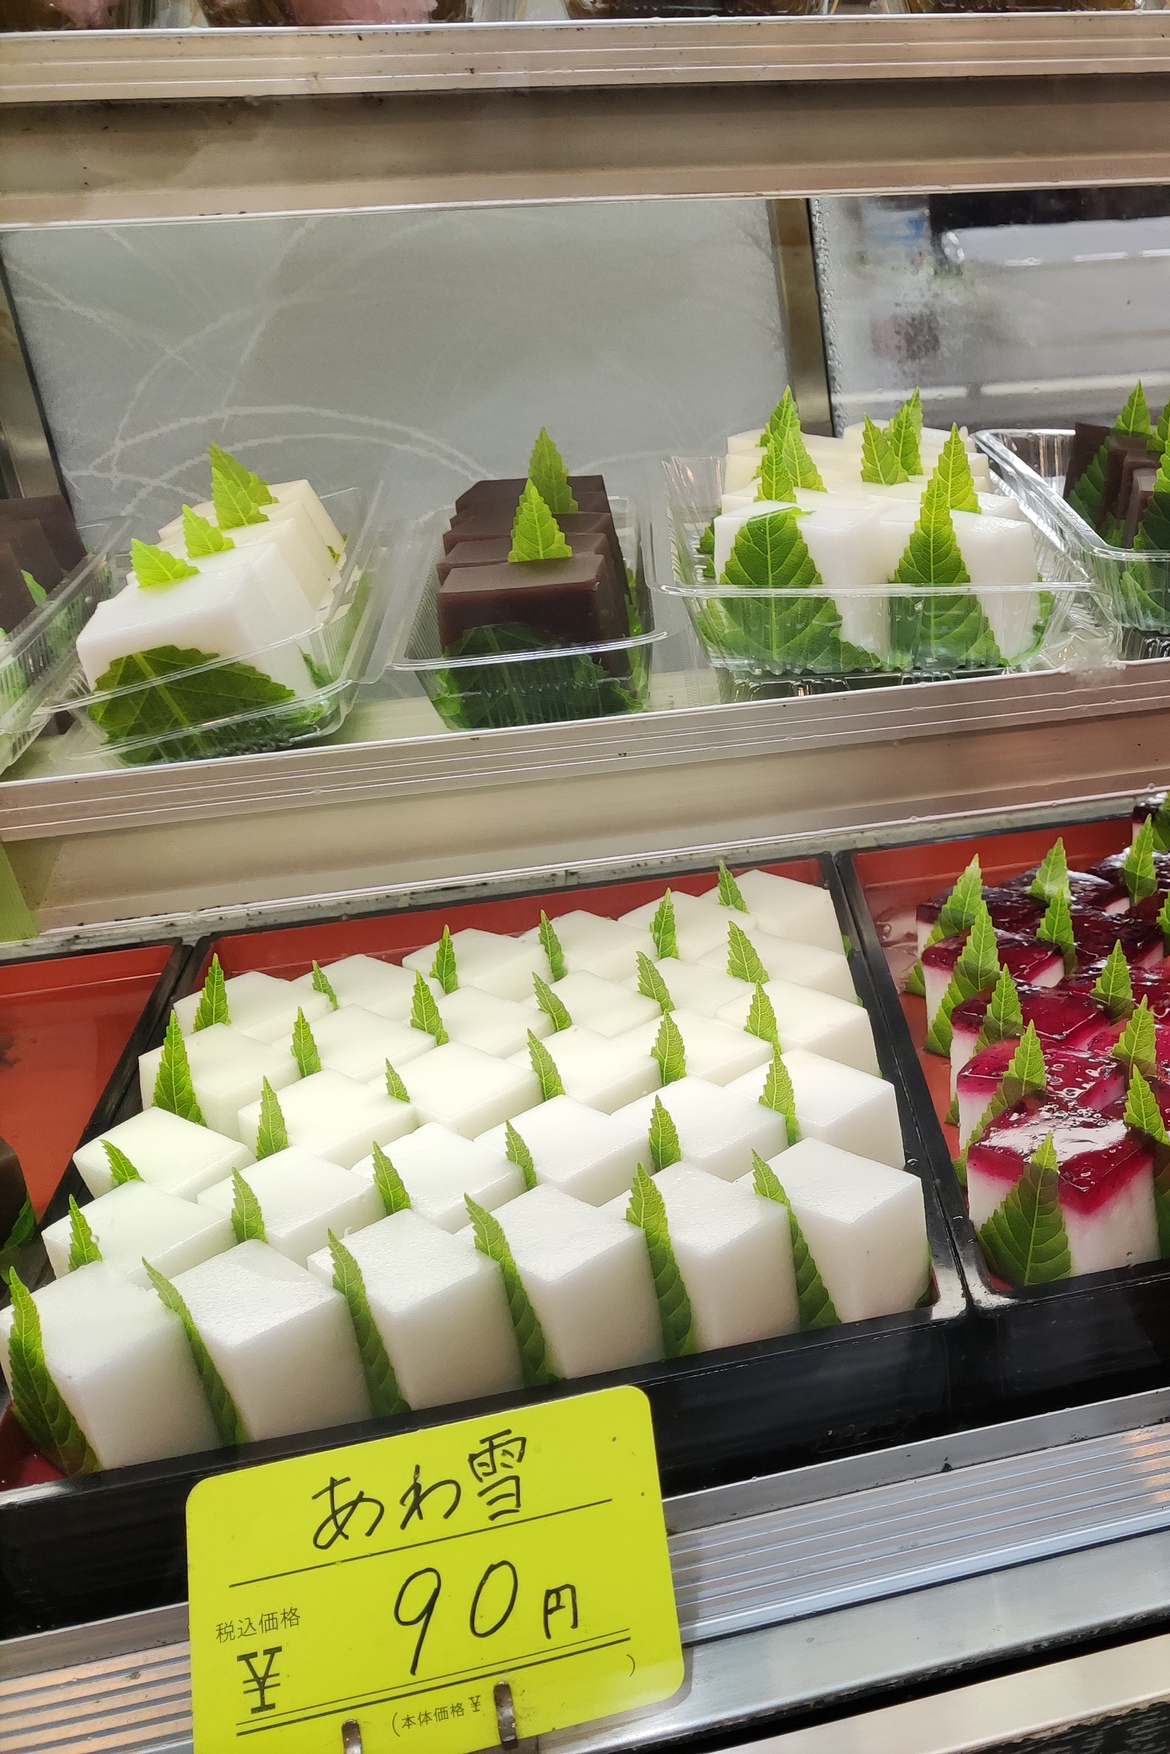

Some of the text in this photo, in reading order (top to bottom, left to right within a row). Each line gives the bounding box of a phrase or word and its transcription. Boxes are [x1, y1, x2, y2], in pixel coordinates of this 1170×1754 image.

[311, 1428, 527, 1550] あわ雪
[215, 1606, 301, 1644] 税込価格
